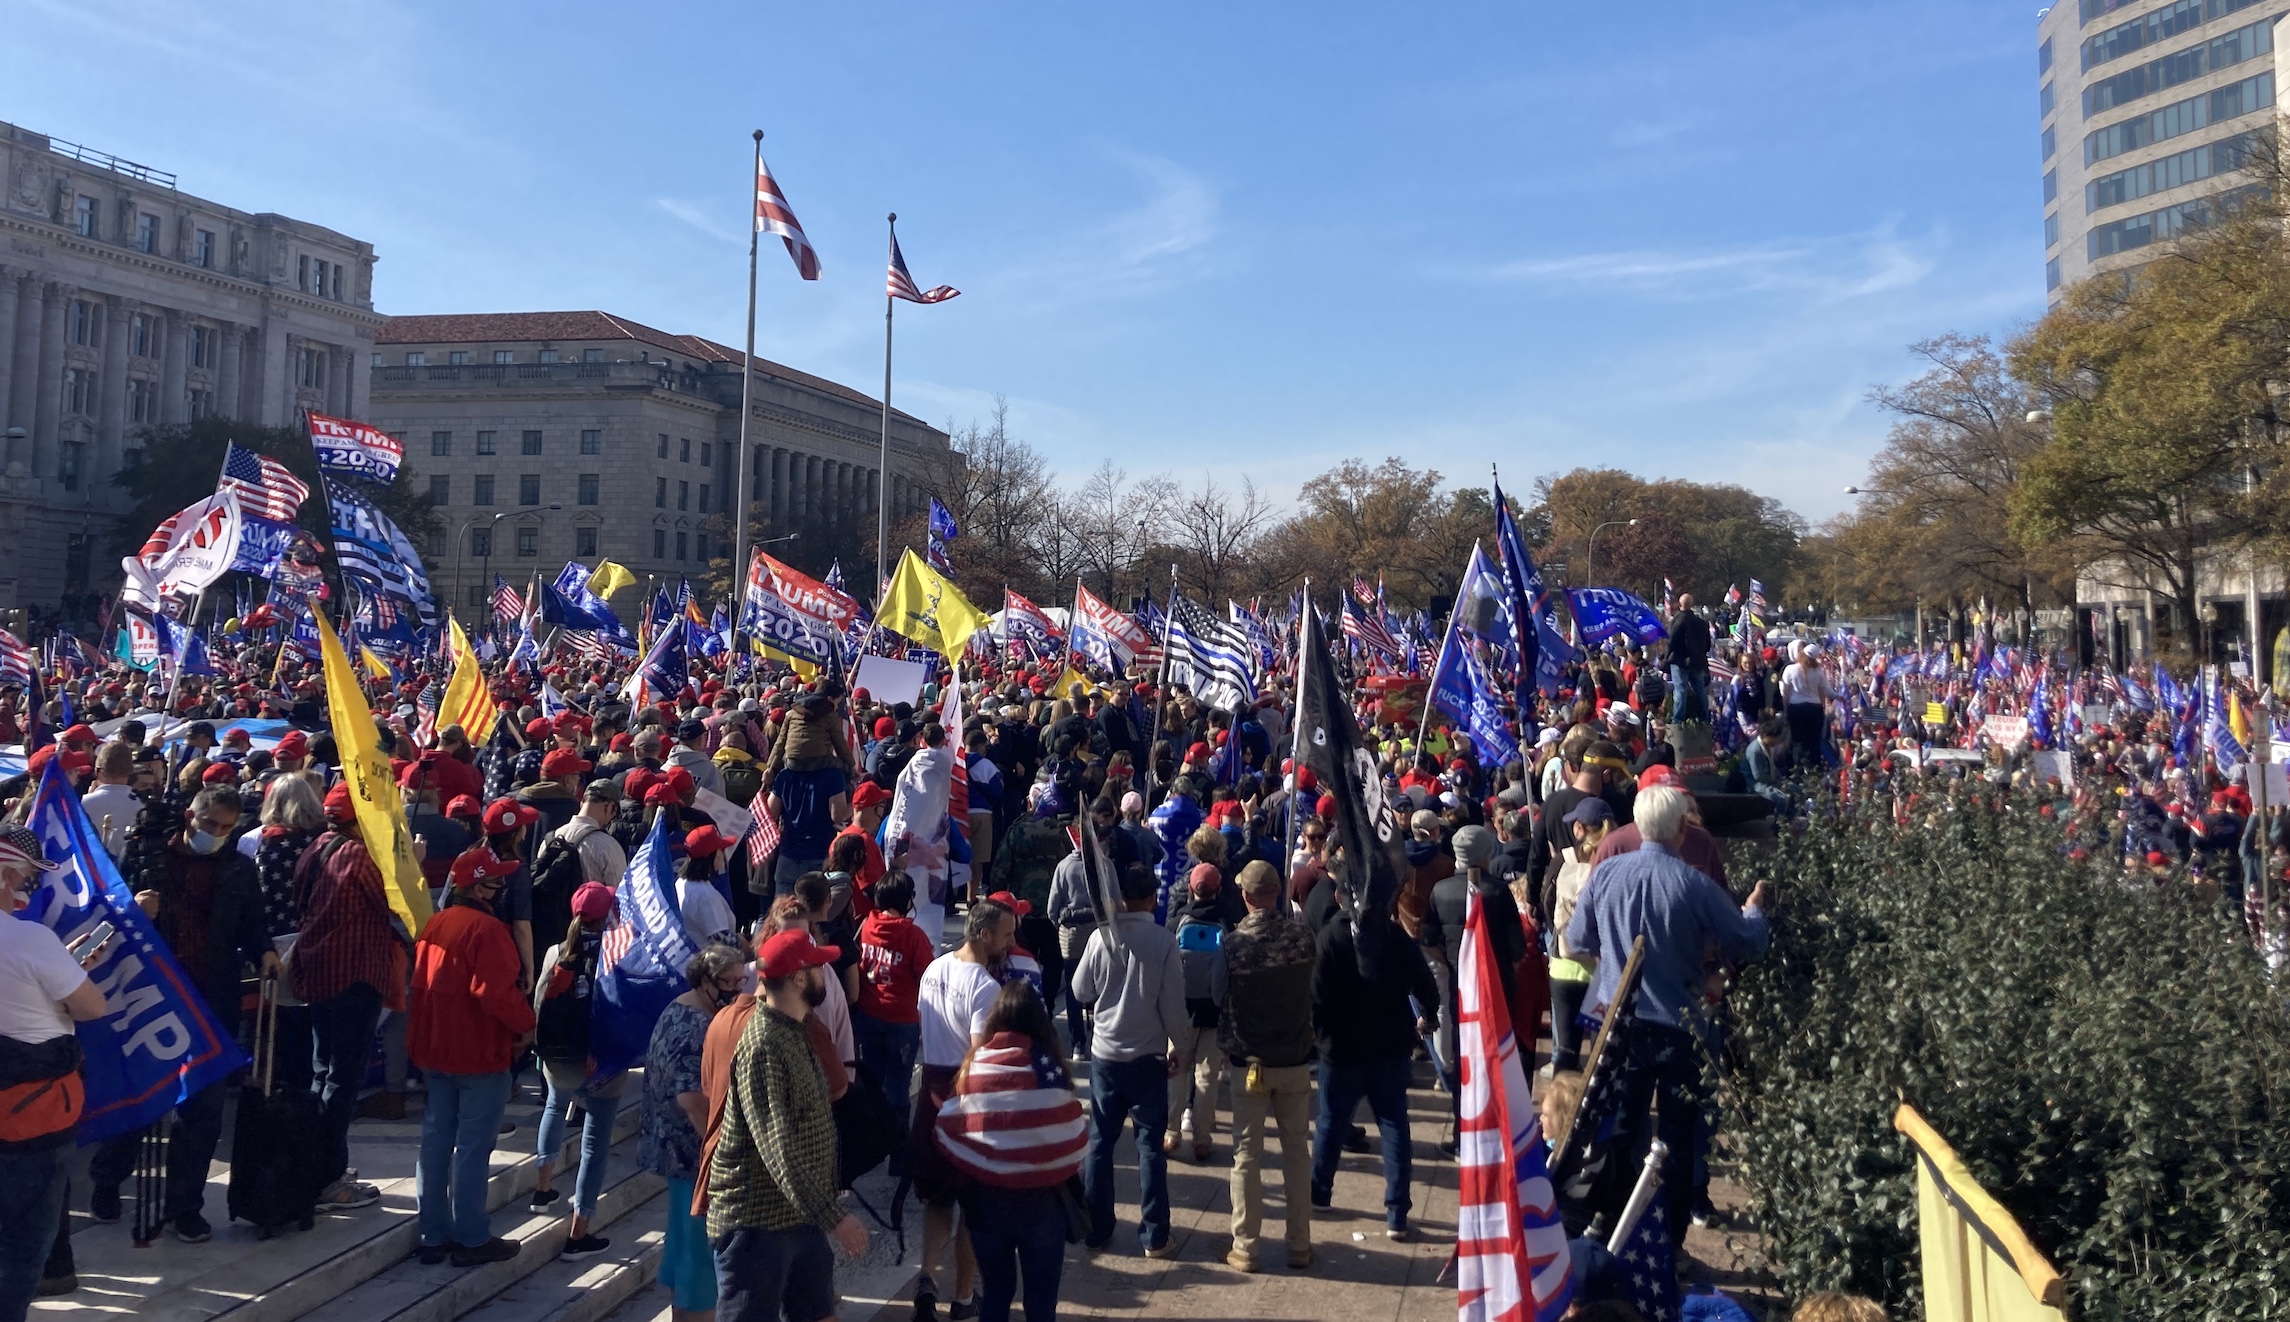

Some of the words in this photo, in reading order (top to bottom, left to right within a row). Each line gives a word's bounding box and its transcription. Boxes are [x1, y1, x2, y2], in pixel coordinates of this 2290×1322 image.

[757, 609, 829, 656] 2020
[1437, 687, 1466, 708] FUCK
[1480, 727, 1521, 762] FEELING
[1472, 692, 1505, 730] 2020
[473, 866, 486, 879] 45
[631, 861, 668, 934] ABOARD
[861, 942, 904, 966] TRUMP
